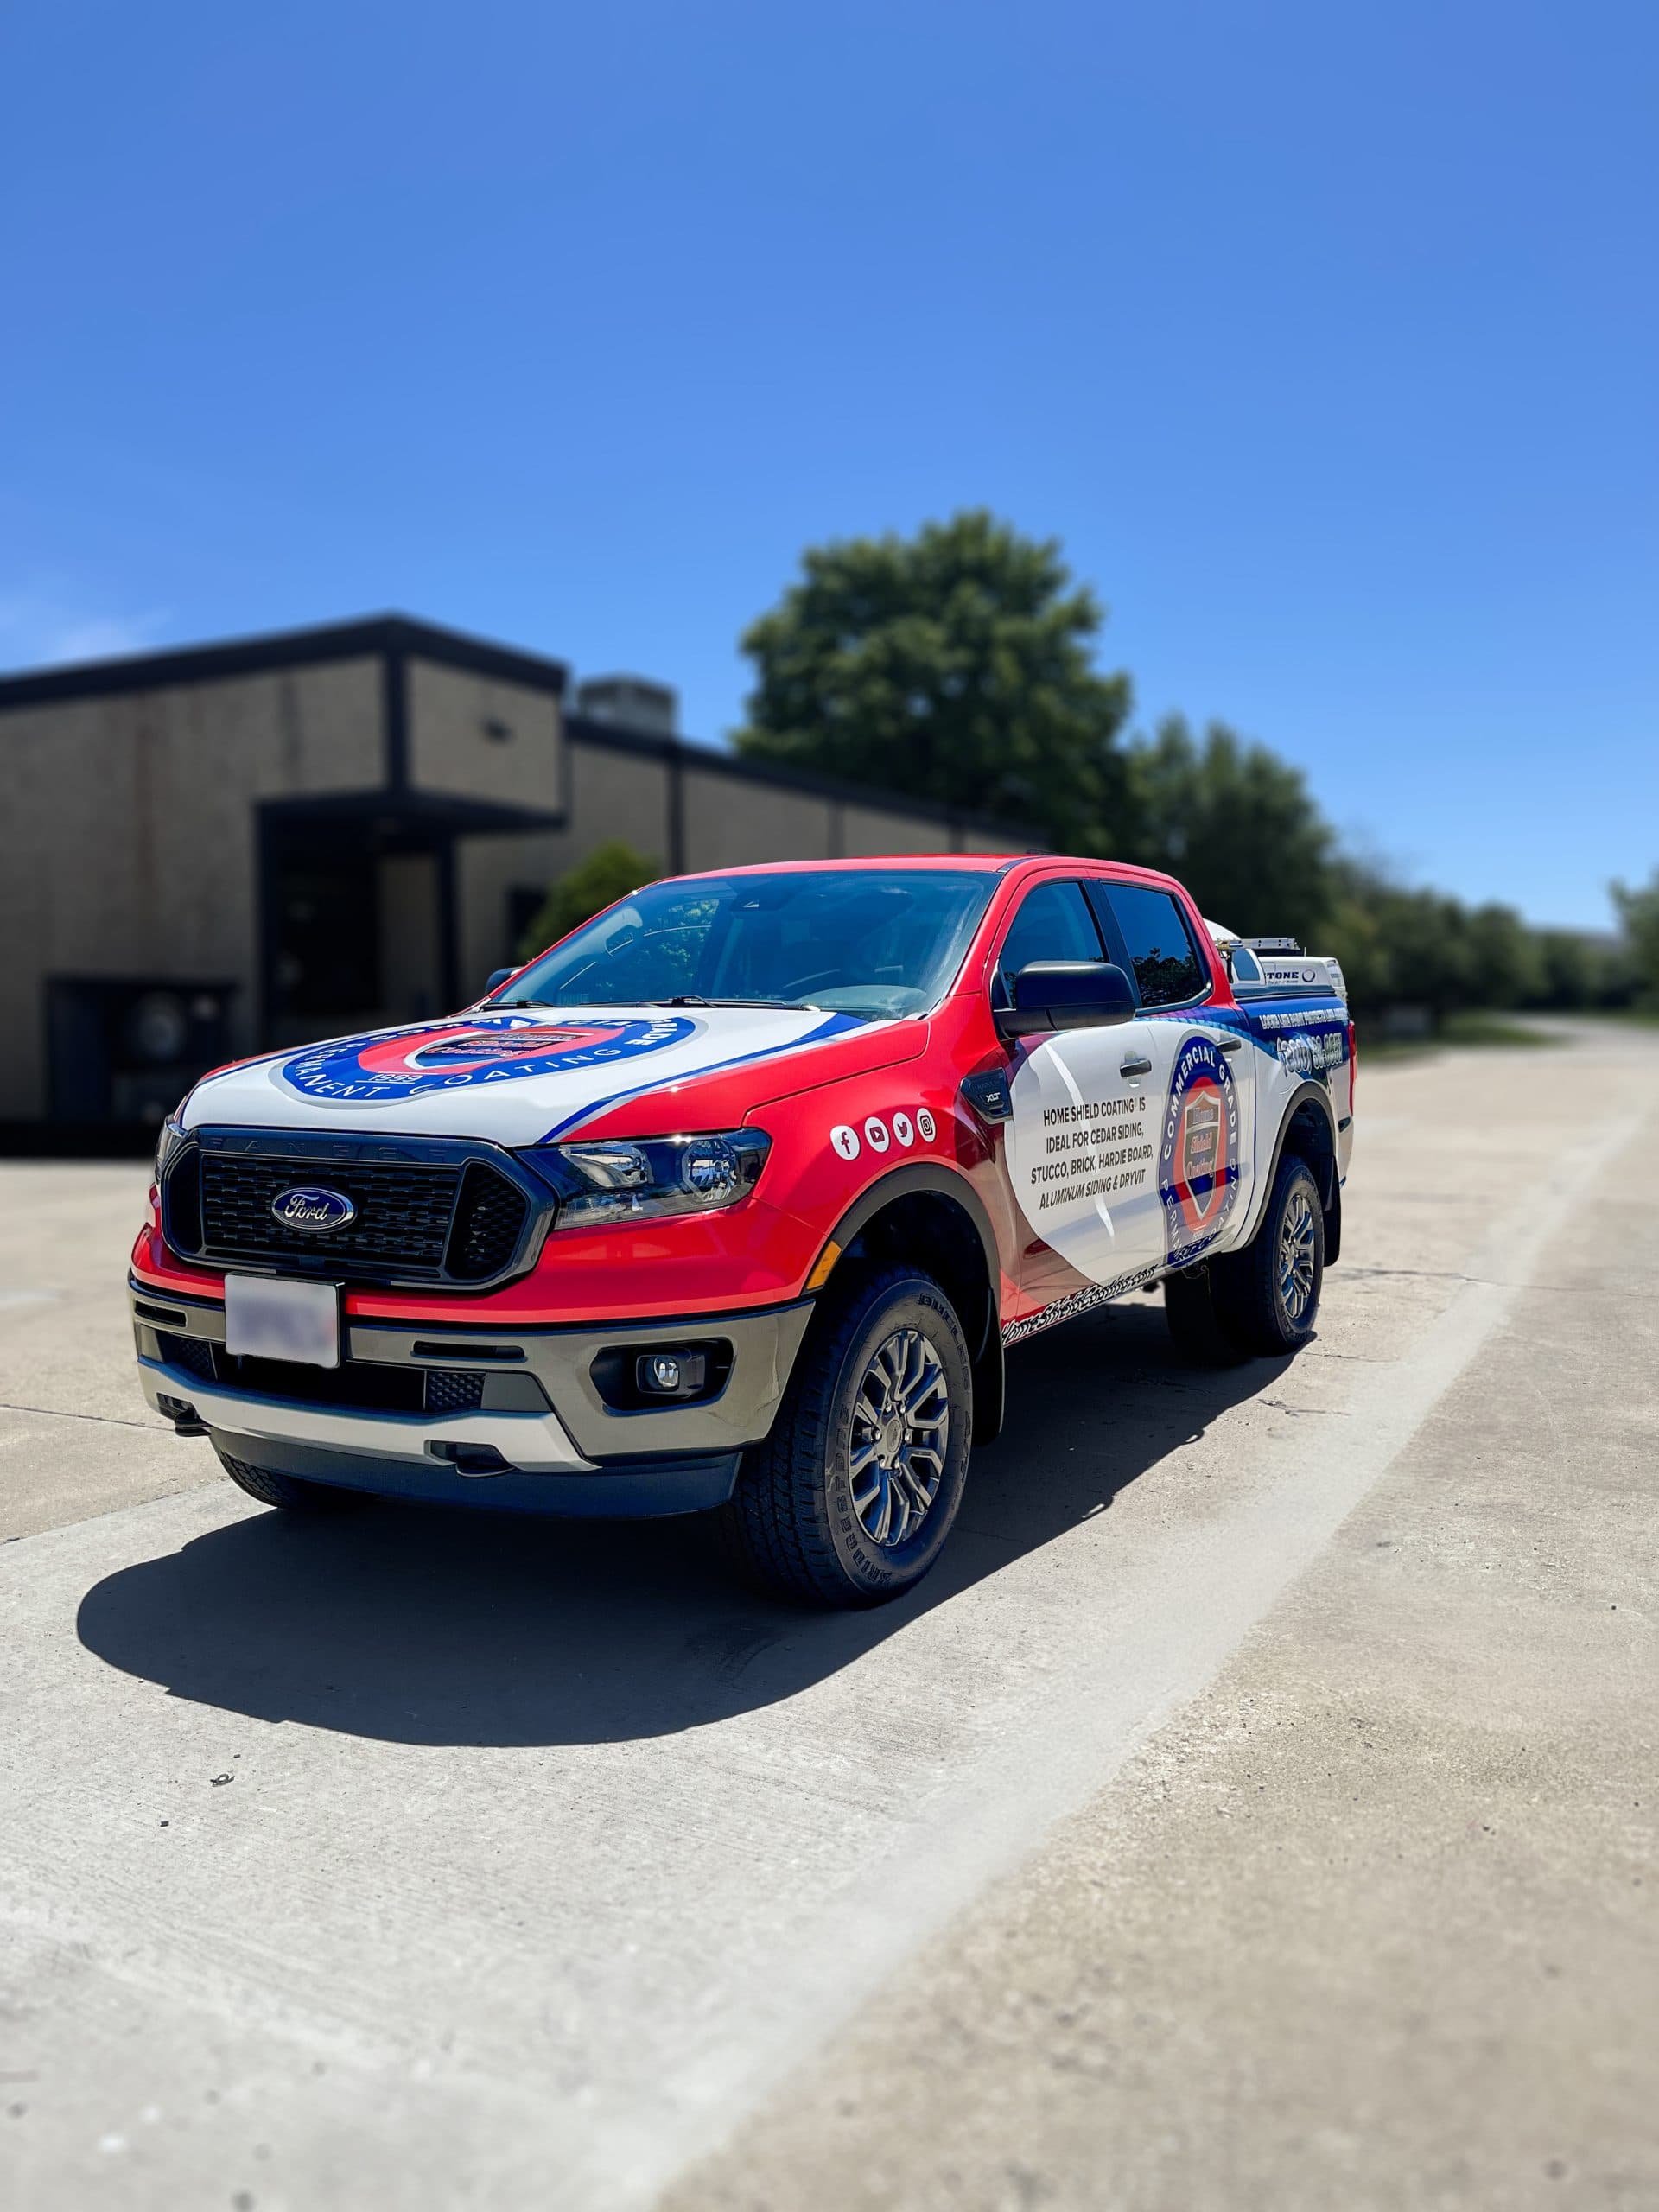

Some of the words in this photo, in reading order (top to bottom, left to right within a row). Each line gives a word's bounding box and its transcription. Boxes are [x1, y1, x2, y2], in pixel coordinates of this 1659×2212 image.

[1264, 971, 1299, 980] TONE
[369, 1018, 640, 1041] COMMCIAL
[409, 1047, 622, 1095] COATING
[985, 1091, 1001, 1103] XLT
[1043, 1107, 1070, 1127] HOME
[1071, 1103, 1100, 1122] SHIELD
[1139, 1096, 1146, 1111] IS
[1164, 1046, 1216, 1160] COMMERCIAL
[1046, 1134, 1071, 1154] IDEAL
[1072, 1130, 1089, 1148] FOR
[1090, 1126, 1116, 1145] CEDAR
[1118, 1122, 1144, 1140] SIDING,
[1031, 1161, 1069, 1185] STUCCO,
[1071, 1155, 1097, 1175] BRICK,
[1098, 1149, 1127, 1169] HARDIE
[1128, 1144, 1154, 1163] BOARD,
[1039, 1183, 1085, 1210] ALUMINUM
[1085, 1176, 1112, 1197] SIDING
[1112, 1175, 1118, 1190] &
[1119, 1169, 1146, 1189] DRYVIT
[284, 1193, 329, 1222] Ford
